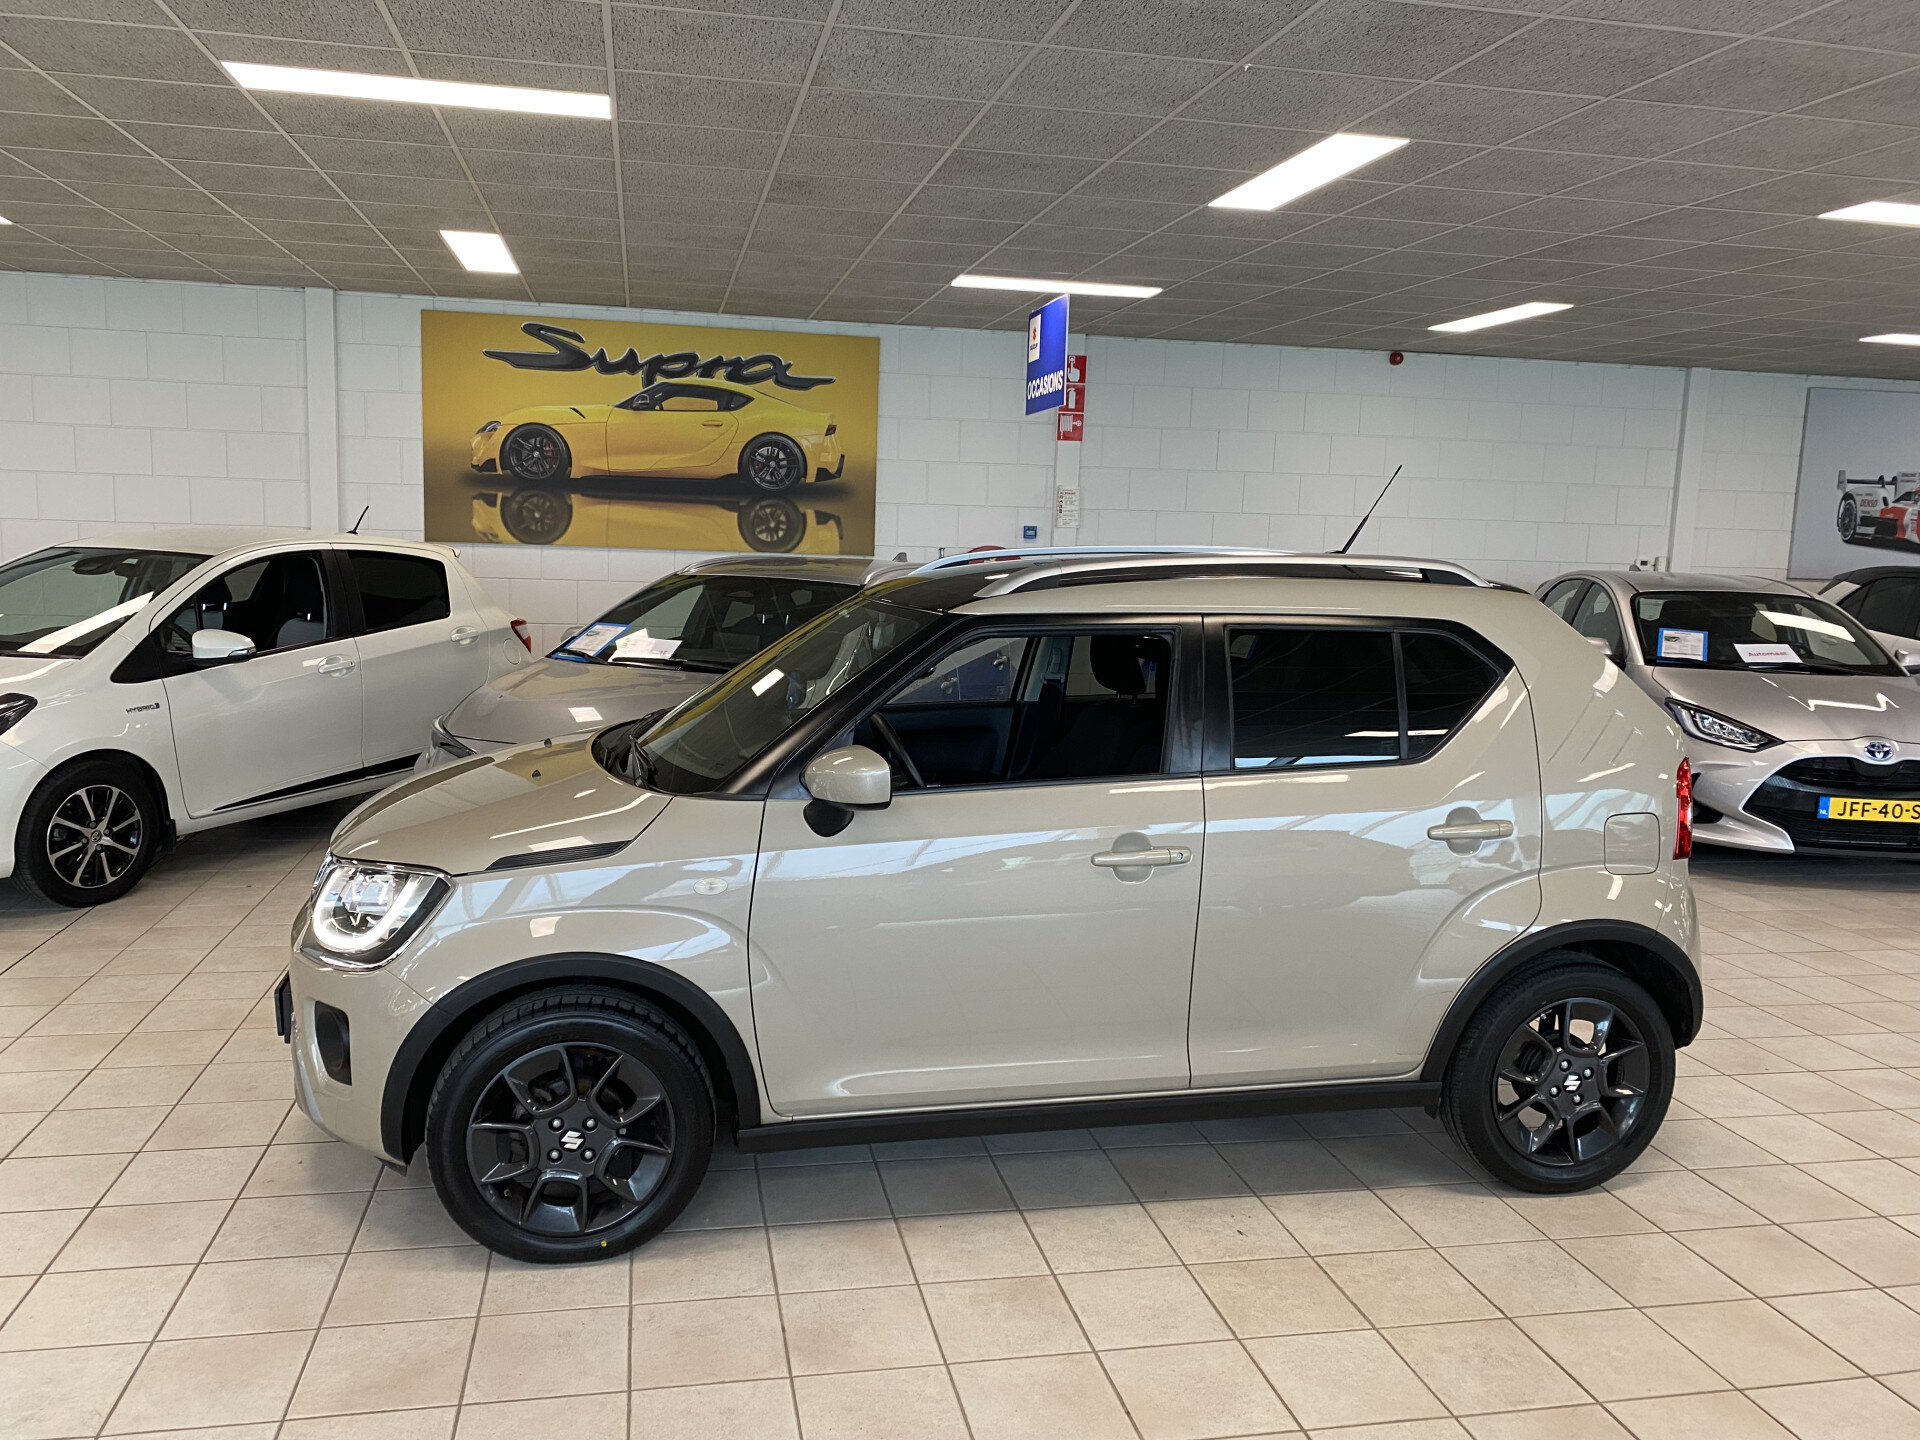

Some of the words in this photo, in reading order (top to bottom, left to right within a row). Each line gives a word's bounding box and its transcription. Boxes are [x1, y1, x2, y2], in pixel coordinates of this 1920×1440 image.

[482, 322, 836, 391] Supra
[1027, 370, 1063, 400] OCCASIONS
[126, 704, 155, 714] HYBRID
